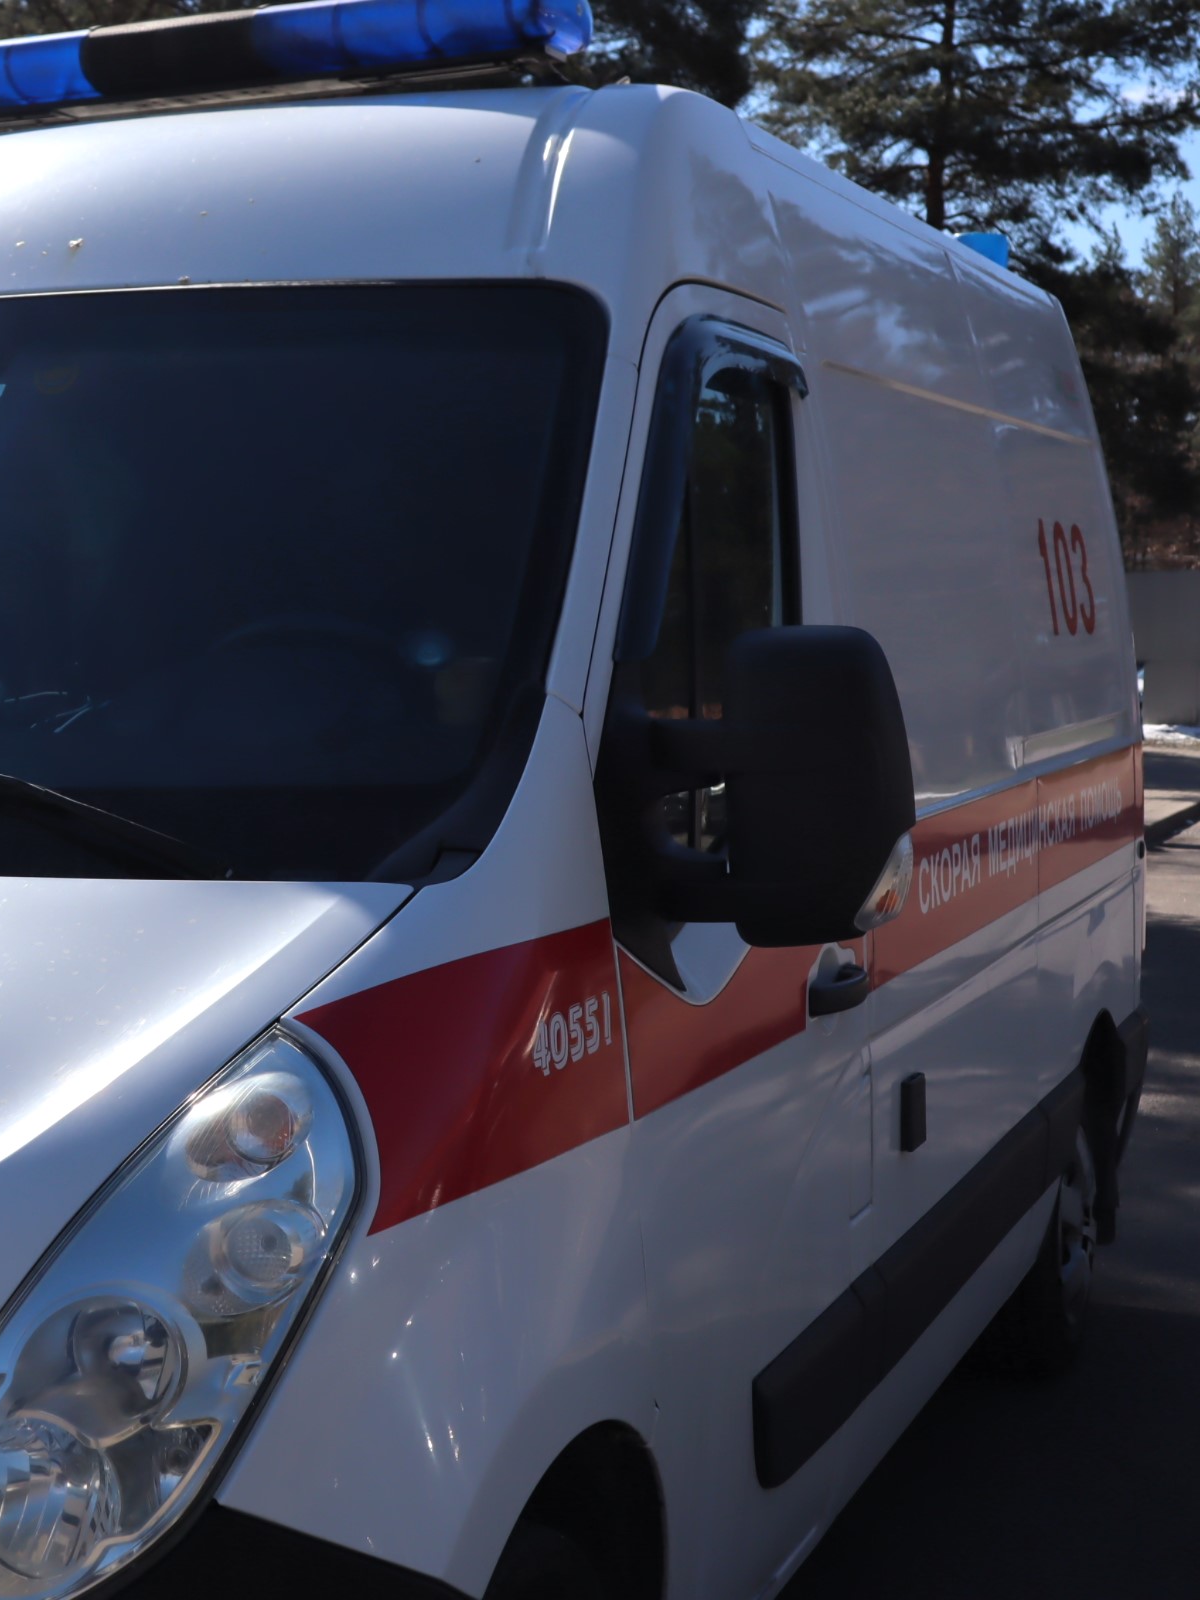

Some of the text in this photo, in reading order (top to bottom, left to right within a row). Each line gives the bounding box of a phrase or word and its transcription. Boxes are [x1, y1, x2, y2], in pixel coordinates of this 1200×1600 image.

[1038, 518, 1095, 636] 103
[918, 776, 1122, 914] СКОРАЯ МЕДИЦИНСКАЯ ПОМОЩЬ
[532, 990, 612, 1076] 40551
